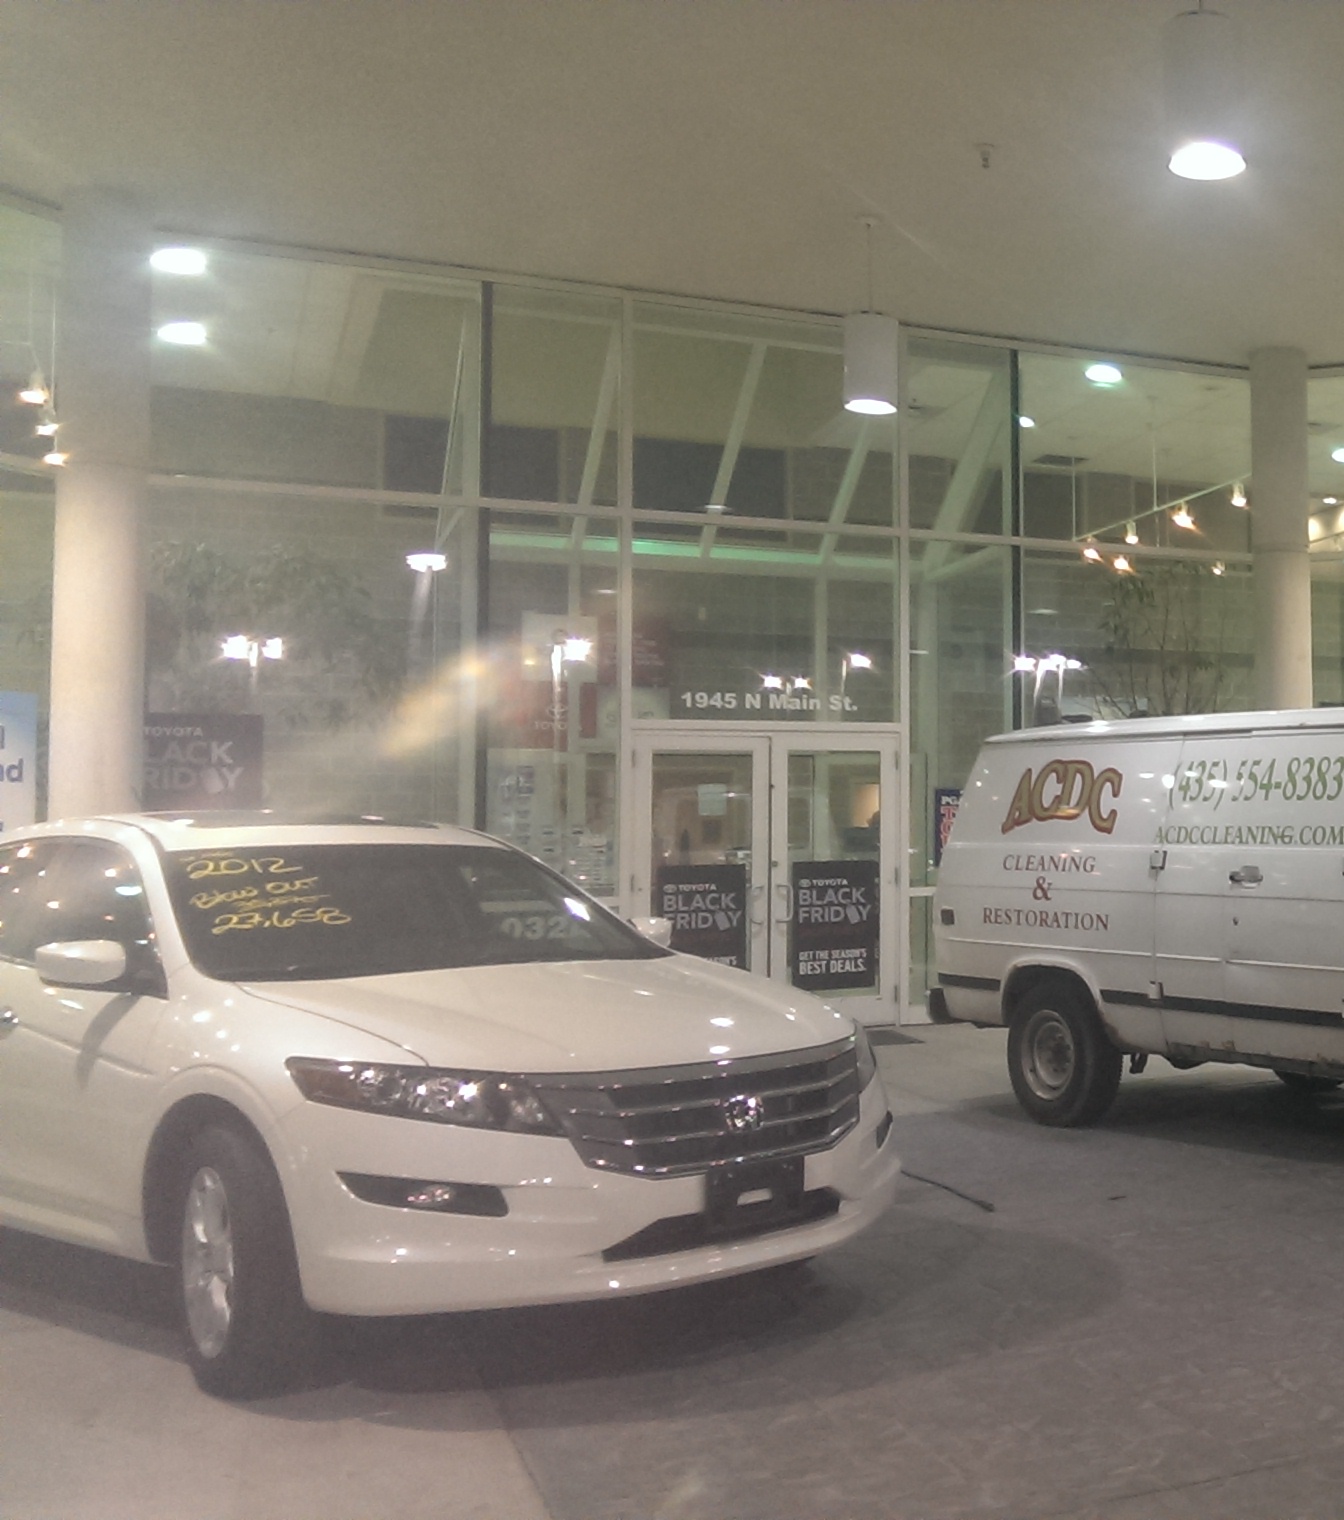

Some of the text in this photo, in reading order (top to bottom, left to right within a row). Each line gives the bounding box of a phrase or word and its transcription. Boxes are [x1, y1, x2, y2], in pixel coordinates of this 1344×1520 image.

[681, 692, 858, 711] 1945 N Main St.
[144, 726, 204, 737] TOYOTA
[146, 741, 234, 765] ACK
[145, 767, 244, 793] RIDY
[941, 795, 959, 805] PG
[1001, 759, 1123, 835] ACDC
[187, 858, 303, 880] 2012
[1003, 854, 1096, 873] CLEANING
[678, 884, 717, 892] TOYOTA
[812, 879, 848, 887] TOYOTA
[1032, 876, 1052, 901] &
[663, 893, 737, 912] BLACK
[799, 887, 866, 905] BLACK
[983, 907, 1109, 931] RESTORATION
[815, 949, 830, 959] THE
[799, 961, 827, 975] BEST
